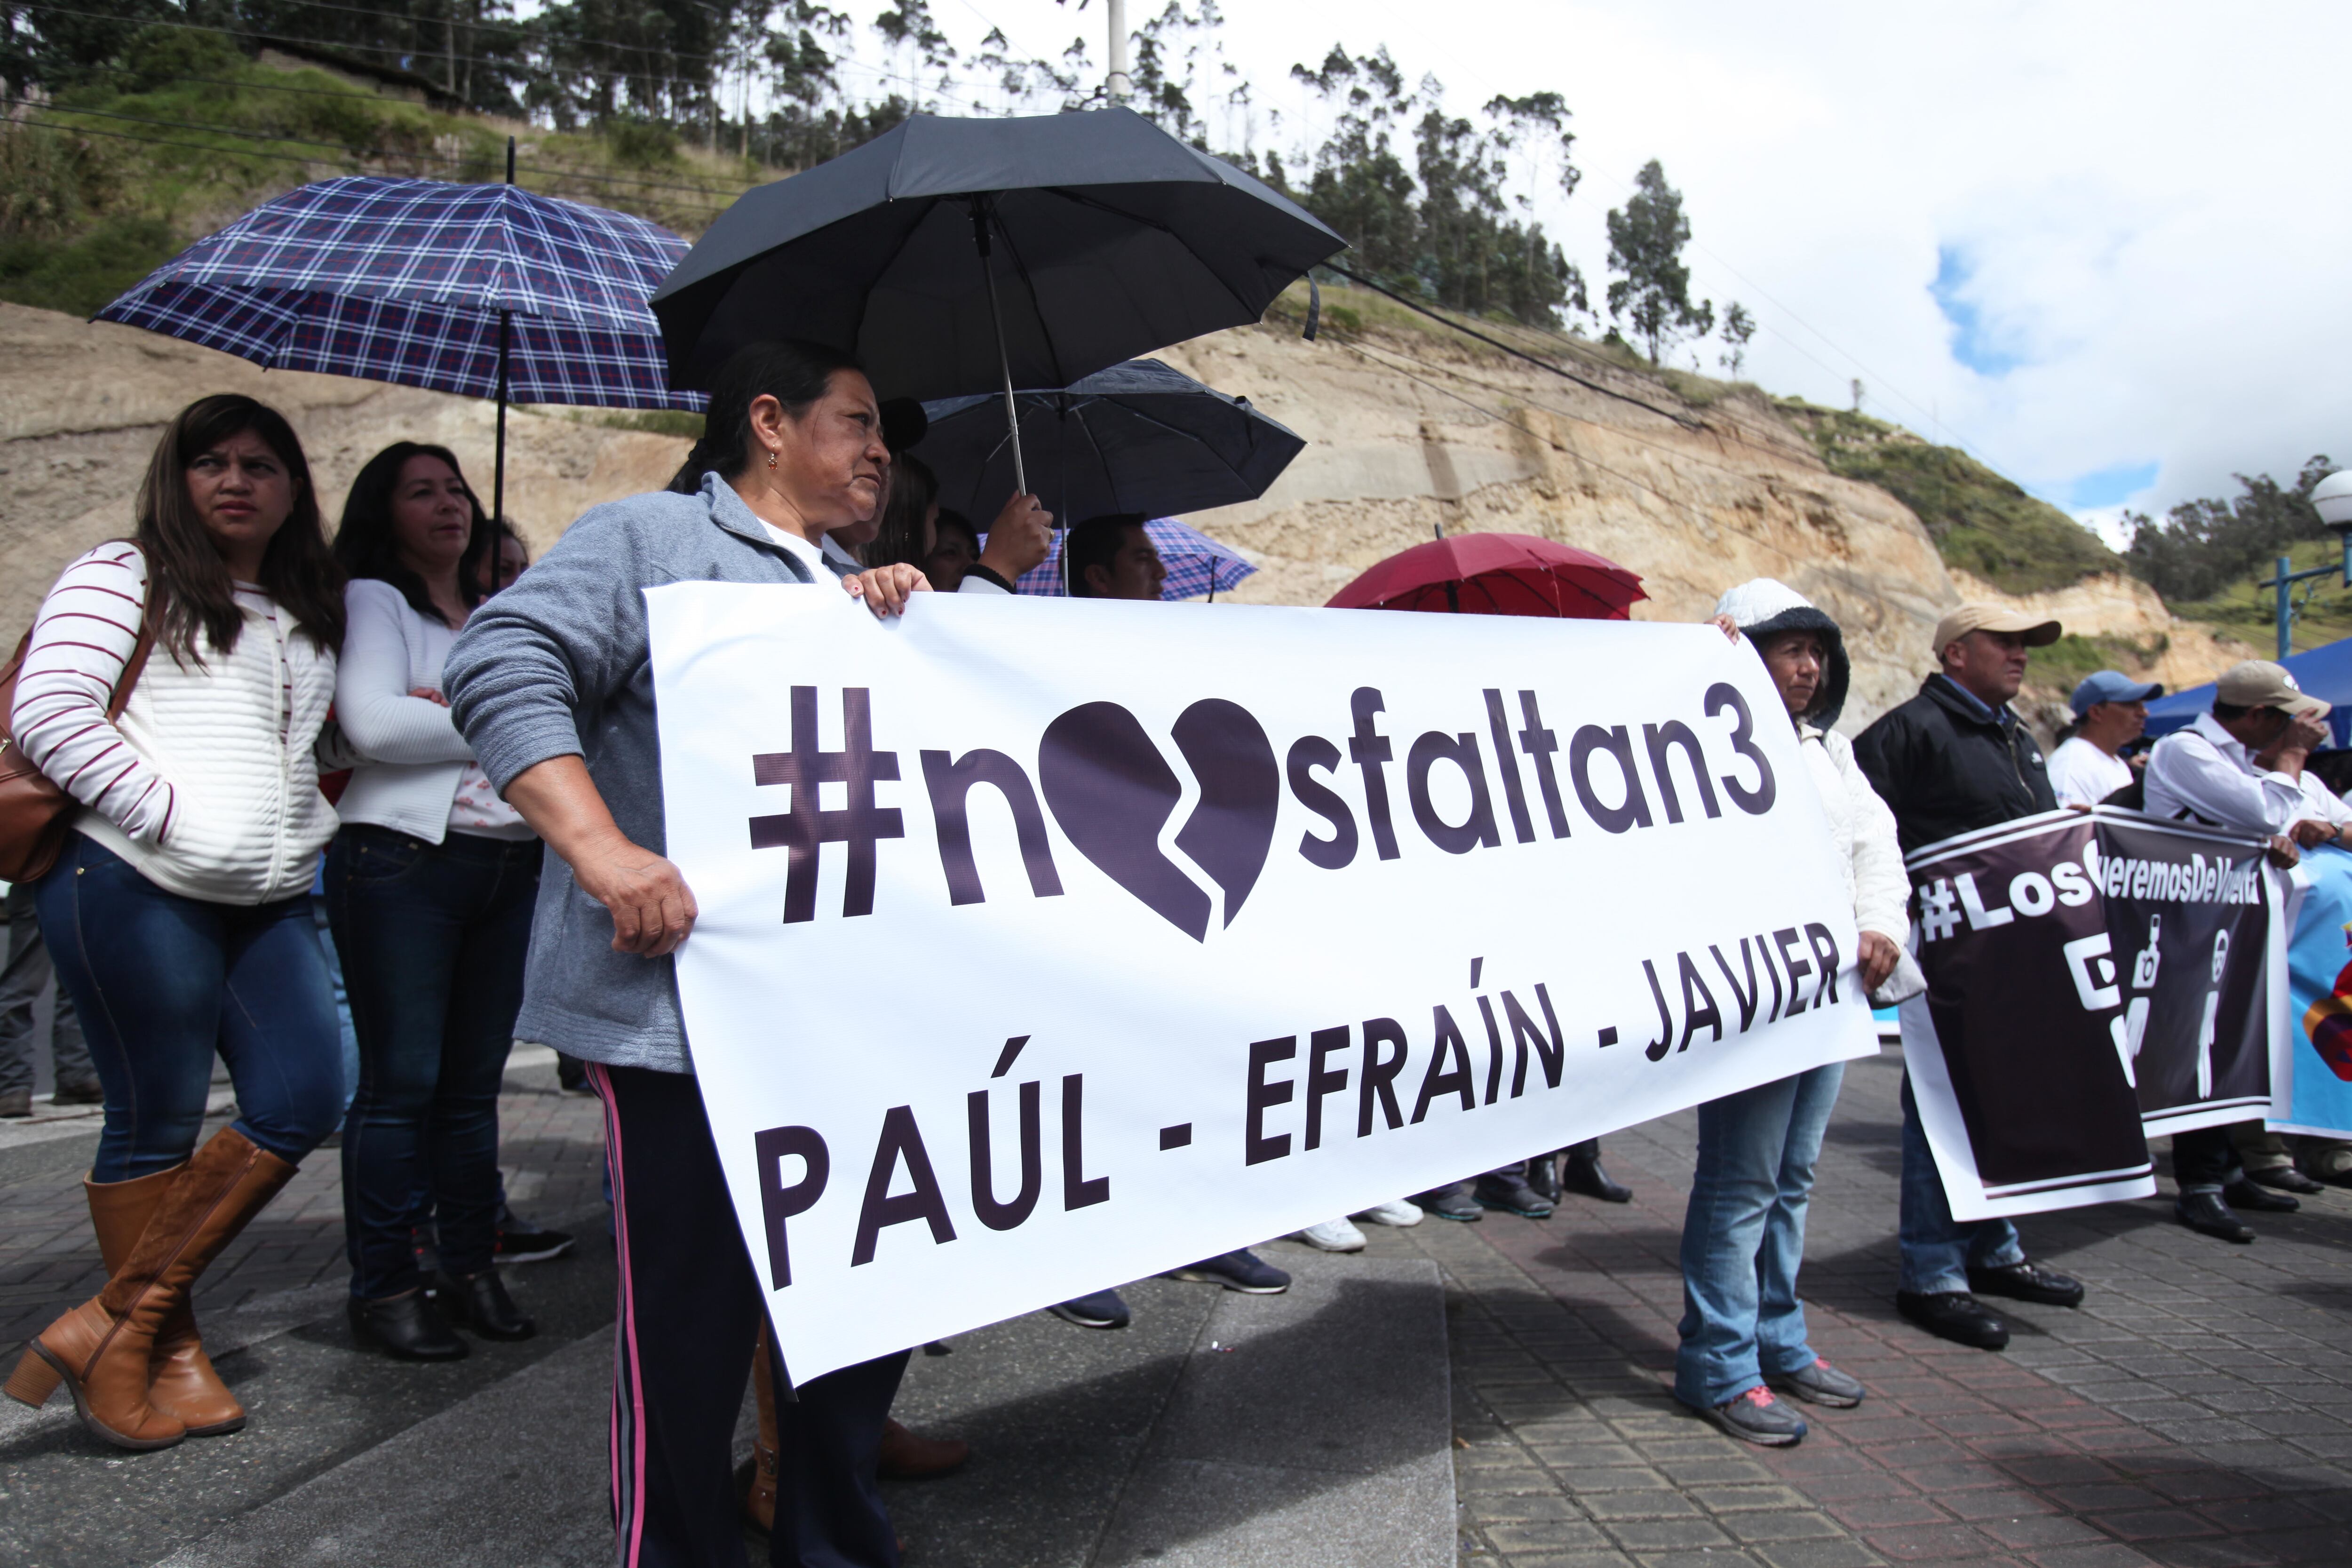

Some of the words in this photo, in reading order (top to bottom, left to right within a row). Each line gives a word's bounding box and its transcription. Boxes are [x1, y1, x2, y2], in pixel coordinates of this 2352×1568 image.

[754, 1035, 1110, 1292] PAÚL
[1160, 1122, 1192, 1151] -
[1246, 956, 1565, 1167] EFRAÍN
[1598, 1026, 1618, 1048] -
[1642, 922, 1840, 1062] JAVIER
